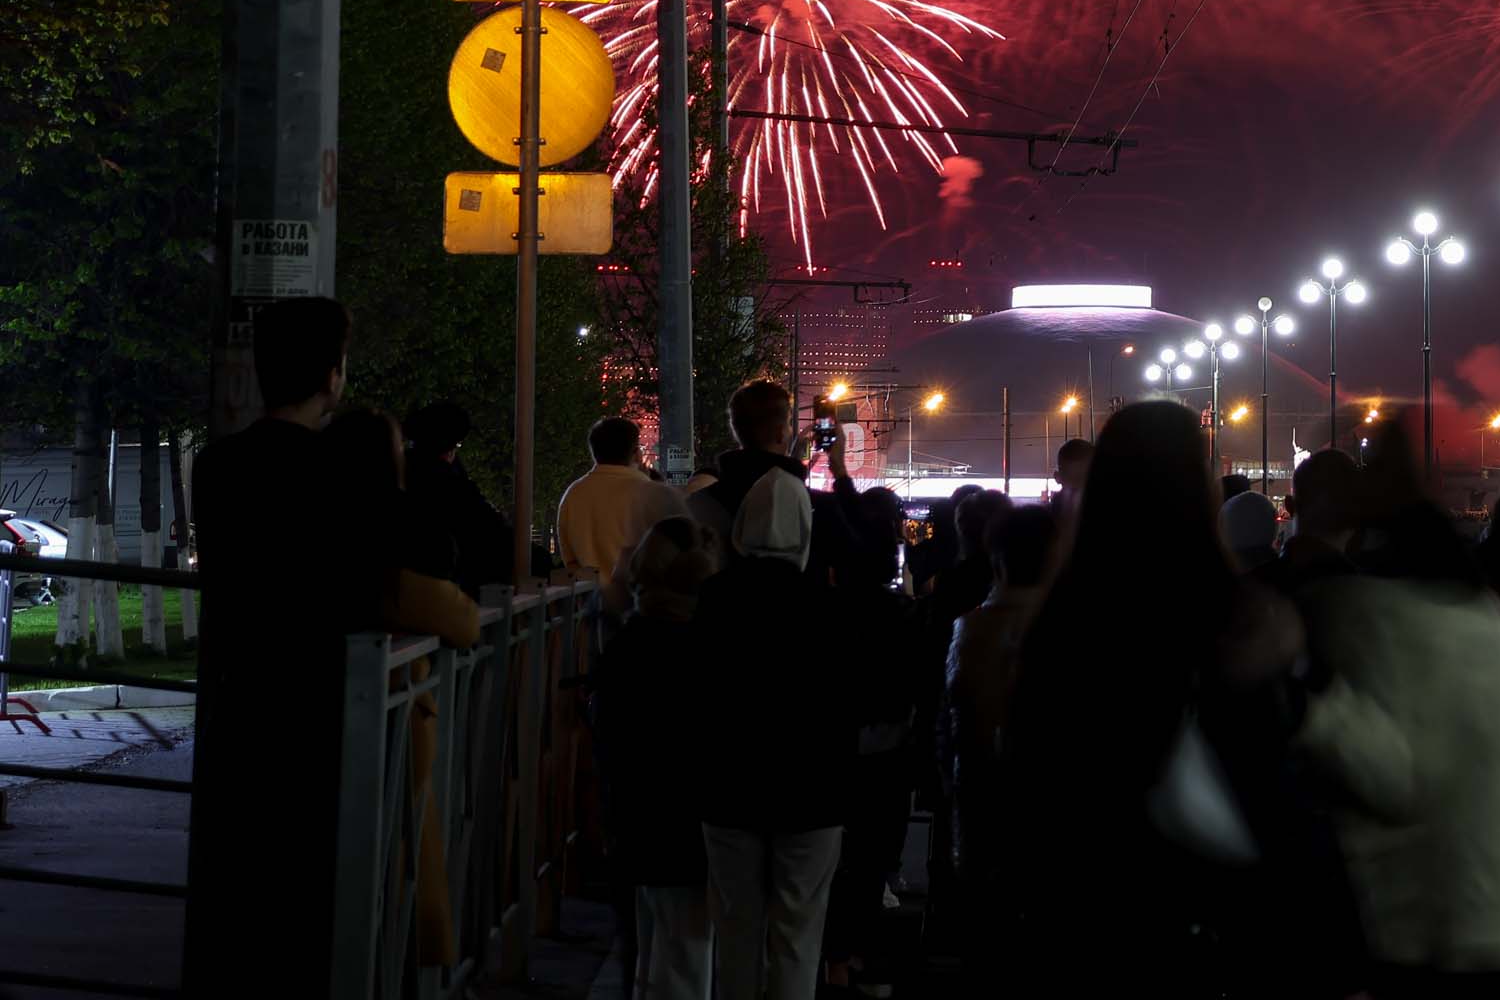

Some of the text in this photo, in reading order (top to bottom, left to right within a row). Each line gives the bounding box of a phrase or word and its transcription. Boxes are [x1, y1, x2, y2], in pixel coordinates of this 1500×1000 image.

[242, 223, 309, 240] РАБОТА
[242, 242, 309, 256] в КАЗАНИ
[0, 469, 73, 521] Mirag
